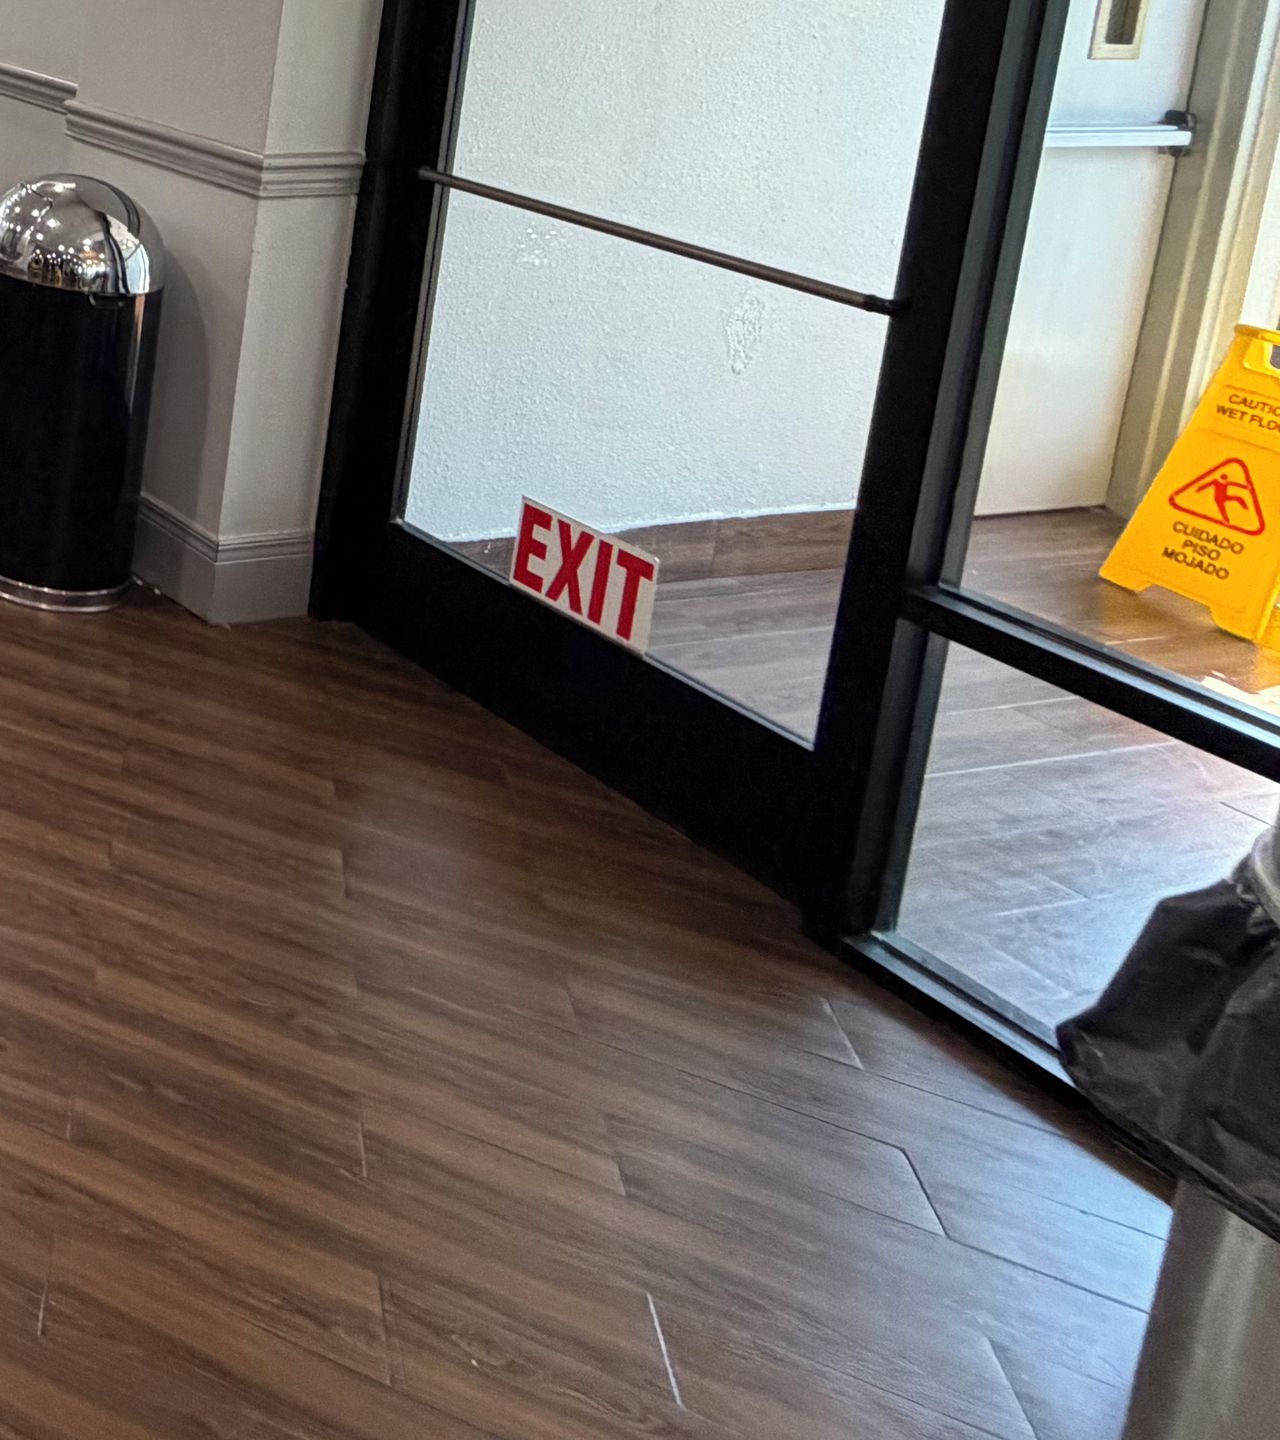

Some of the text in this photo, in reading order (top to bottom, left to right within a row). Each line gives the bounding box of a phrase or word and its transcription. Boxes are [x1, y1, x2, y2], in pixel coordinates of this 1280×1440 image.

[1216, 404, 1248, 421] WET
[1172, 521, 1244, 555] CUIDADO
[1182, 539, 1221, 561] PISO
[513, 503, 654, 641] EXIT
[1161, 546, 1230, 580] MOJADO
